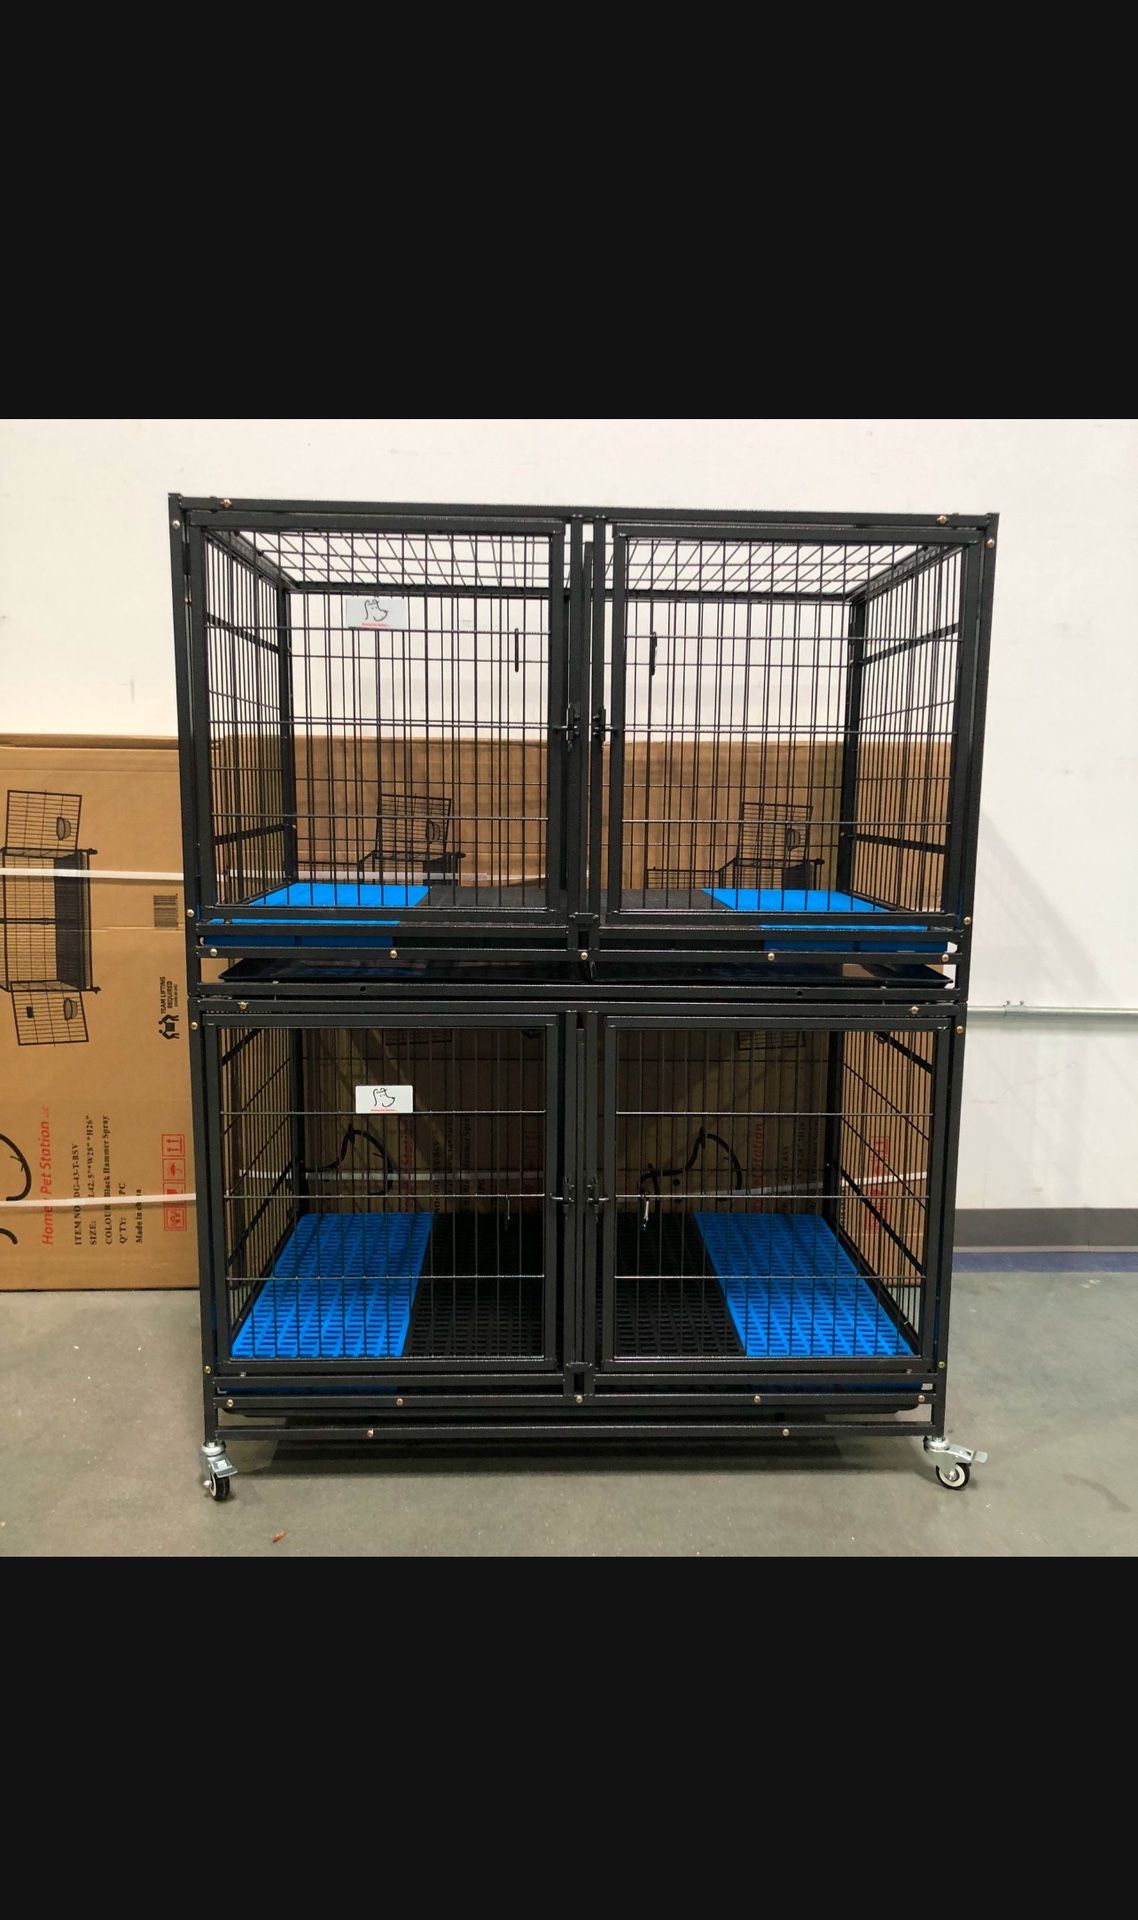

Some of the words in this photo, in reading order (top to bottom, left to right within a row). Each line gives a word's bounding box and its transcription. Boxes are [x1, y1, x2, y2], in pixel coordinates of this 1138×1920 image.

[102, 1115, 111, 1139] Spray
[38, 1121, 52, 1170] Station
[40, 1173, 52, 1195] Pet
[42, 1198, 54, 1245] Home
[136, 1212, 142, 1220] in
[74, 1221, 82, 1245] ITEM
[89, 1220, 97, 1245] SIZE:
